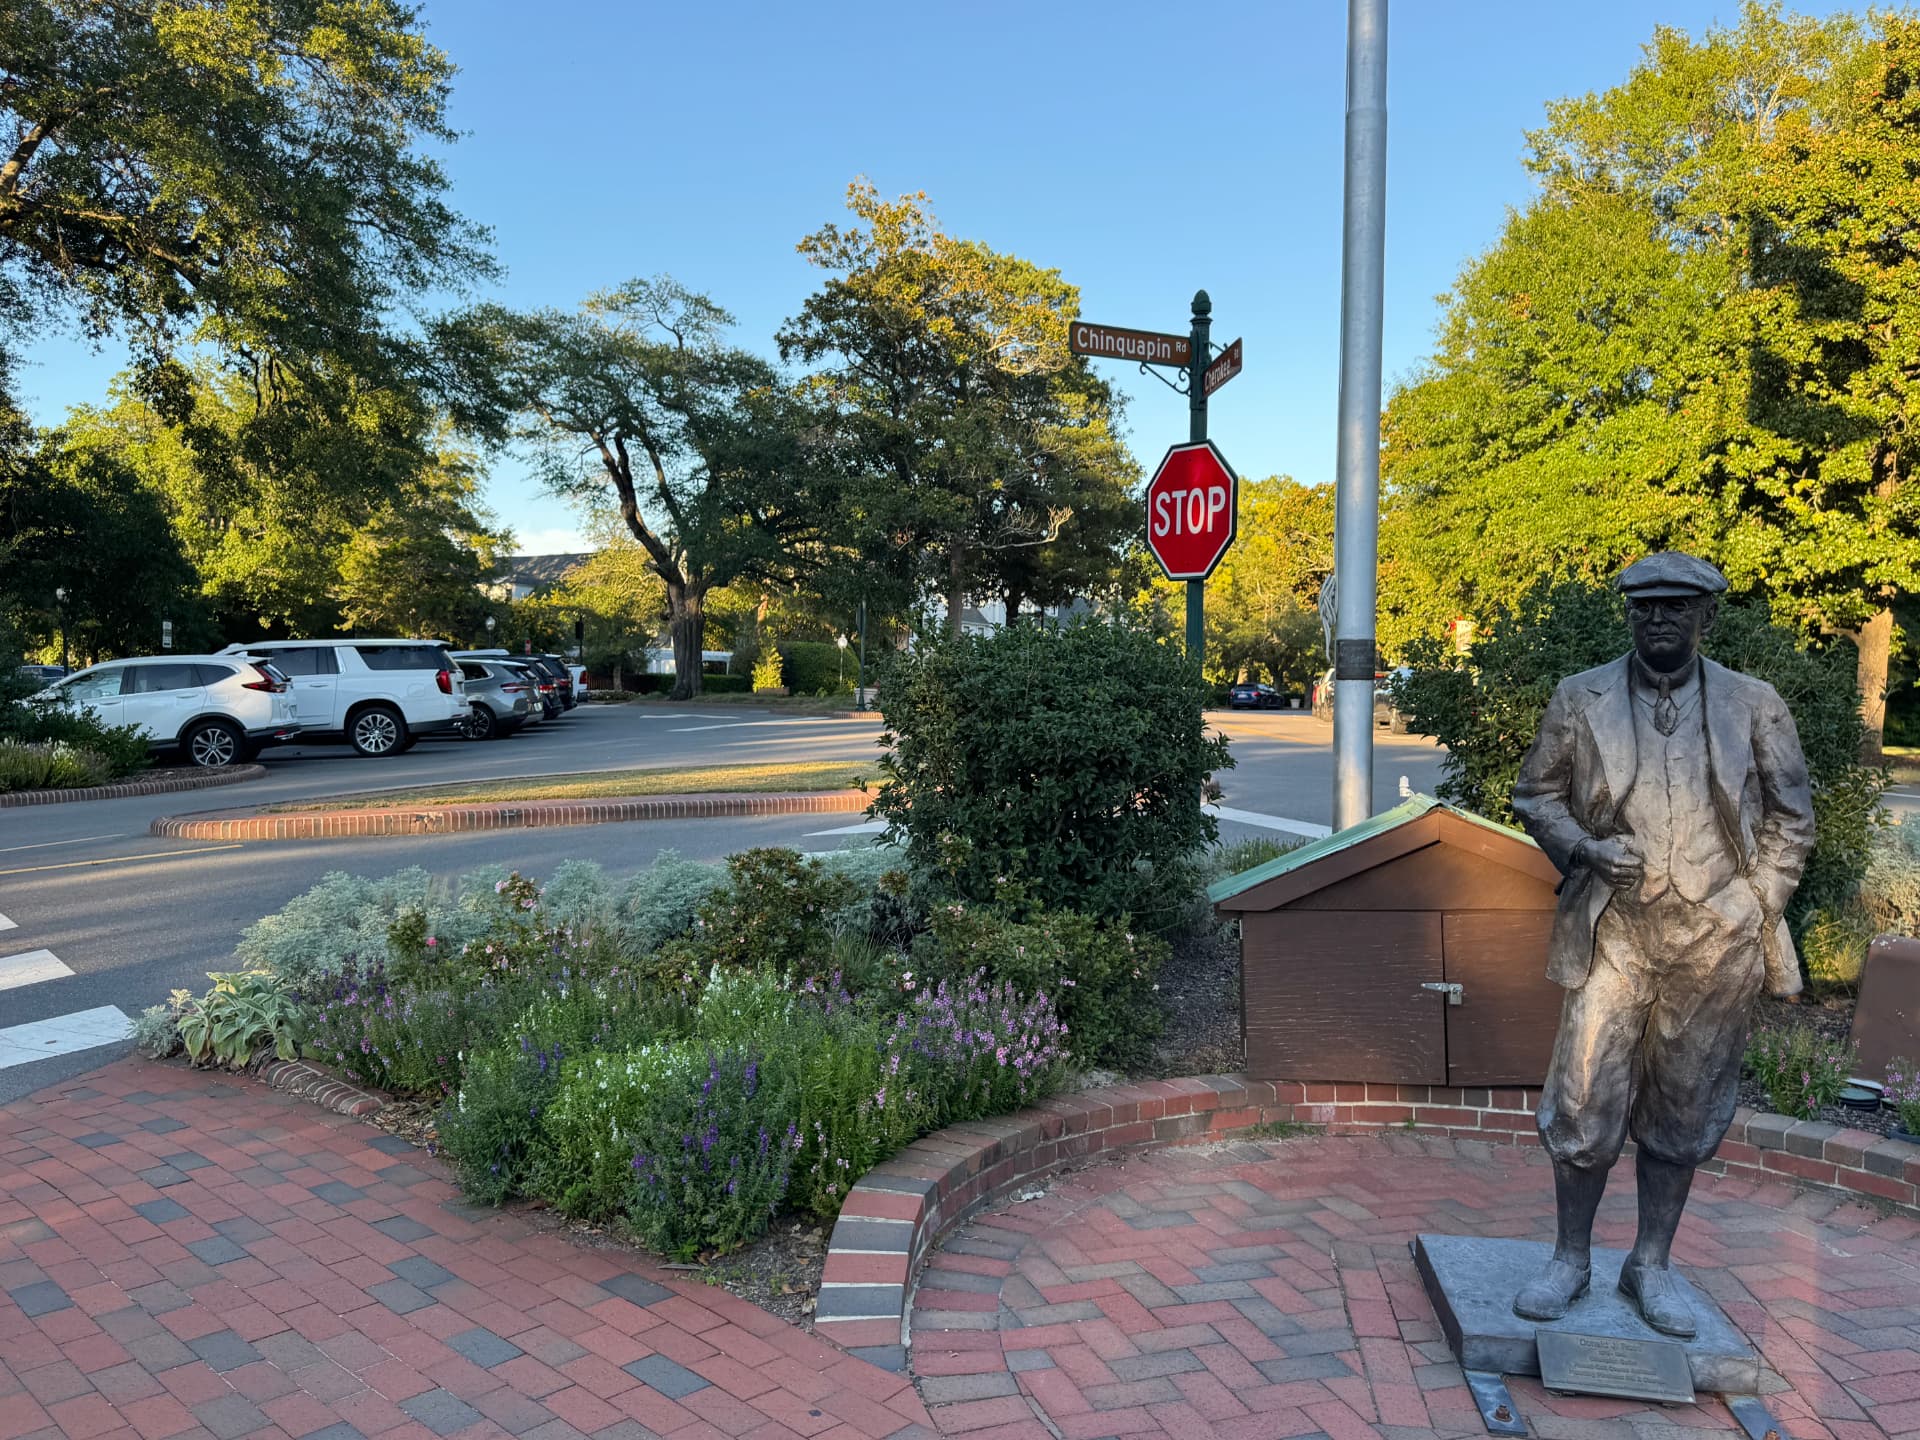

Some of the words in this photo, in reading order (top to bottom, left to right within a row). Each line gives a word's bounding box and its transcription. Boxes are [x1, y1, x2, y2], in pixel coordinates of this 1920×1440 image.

[1077, 327, 1171, 360] Chinquapin
[1175, 341, 1187, 353] Rd
[1204, 359, 1231, 392] Cherokee
[1154, 485, 1226, 537] STOP
